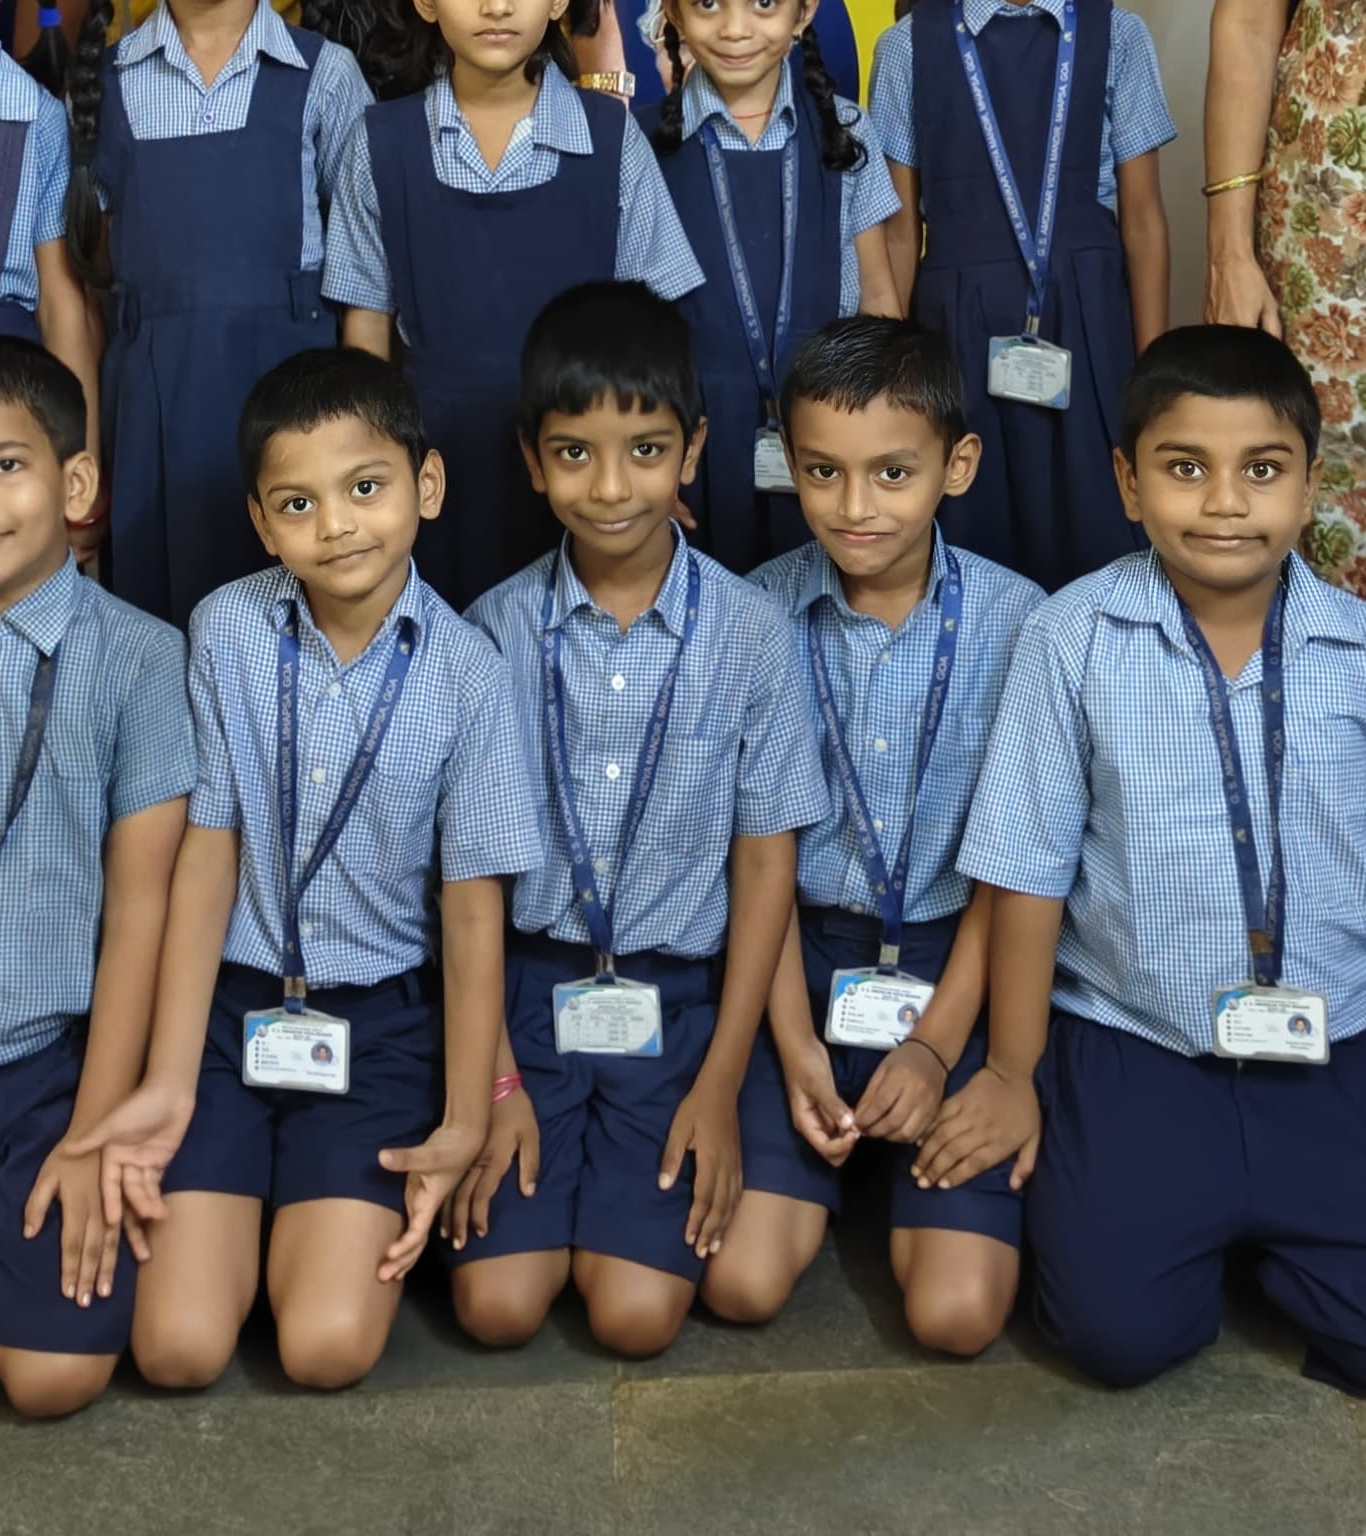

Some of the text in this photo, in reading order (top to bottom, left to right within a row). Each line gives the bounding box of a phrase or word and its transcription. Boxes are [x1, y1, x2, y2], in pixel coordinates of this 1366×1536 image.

[961, 49, 977, 72] GOA
[1059, 60, 1070, 81] GOA
[282, 661, 291, 688] GOA
[934, 654, 949, 682] GOA
[381, 676, 398, 704] GOA
[282, 792, 291, 824] VIDYA
[843, 777, 867, 833] AMONKAR
